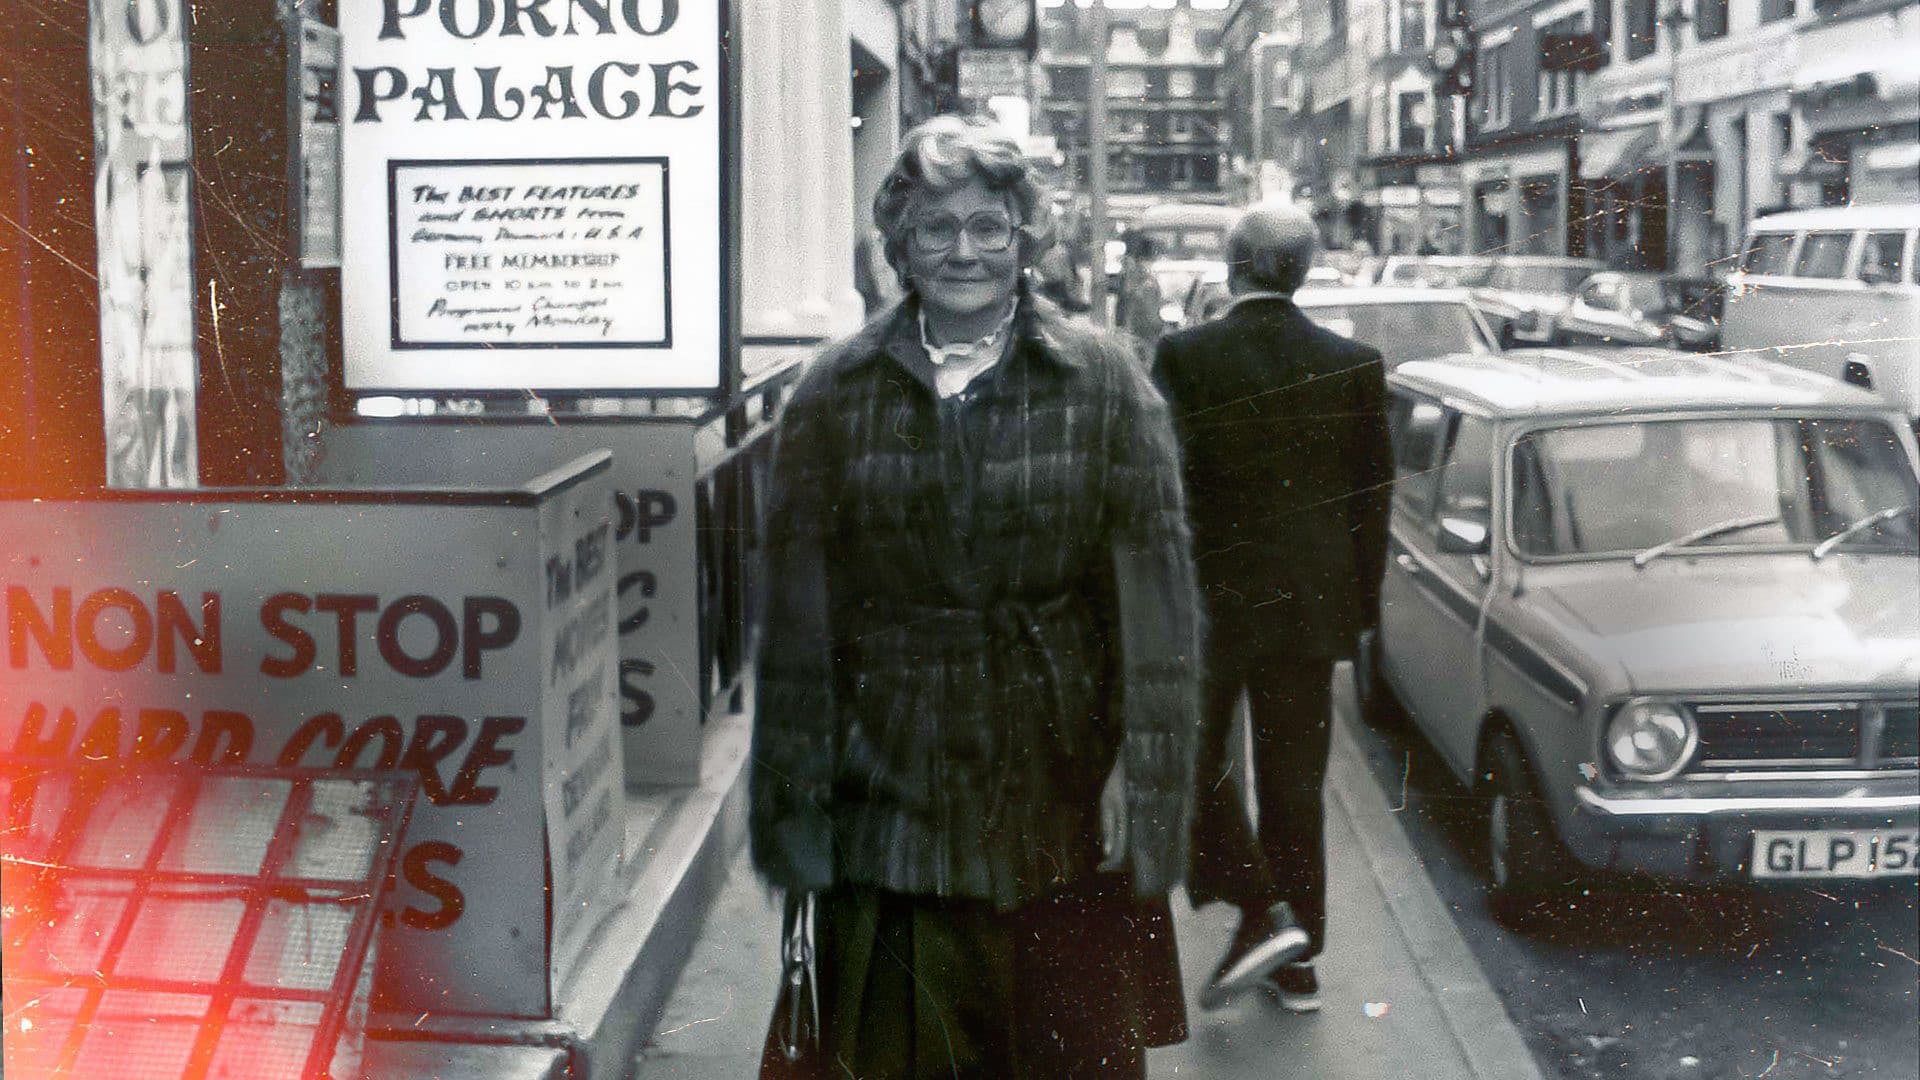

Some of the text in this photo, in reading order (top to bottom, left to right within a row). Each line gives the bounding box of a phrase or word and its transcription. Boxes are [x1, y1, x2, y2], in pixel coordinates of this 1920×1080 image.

[378, 0, 680, 39] PORNO
[353, 60, 704, 122] PALACE
[412, 184, 640, 204] The BEST FEATURES
[445, 253, 620, 270] FREE MEMBERSHIP
[7, 586, 223, 675] NON
[259, 591, 523, 680] STOP
[13, 702, 254, 770] HARD
[277, 711, 526, 807] CORE
[1768, 835, 1919, 872] GLP 15
